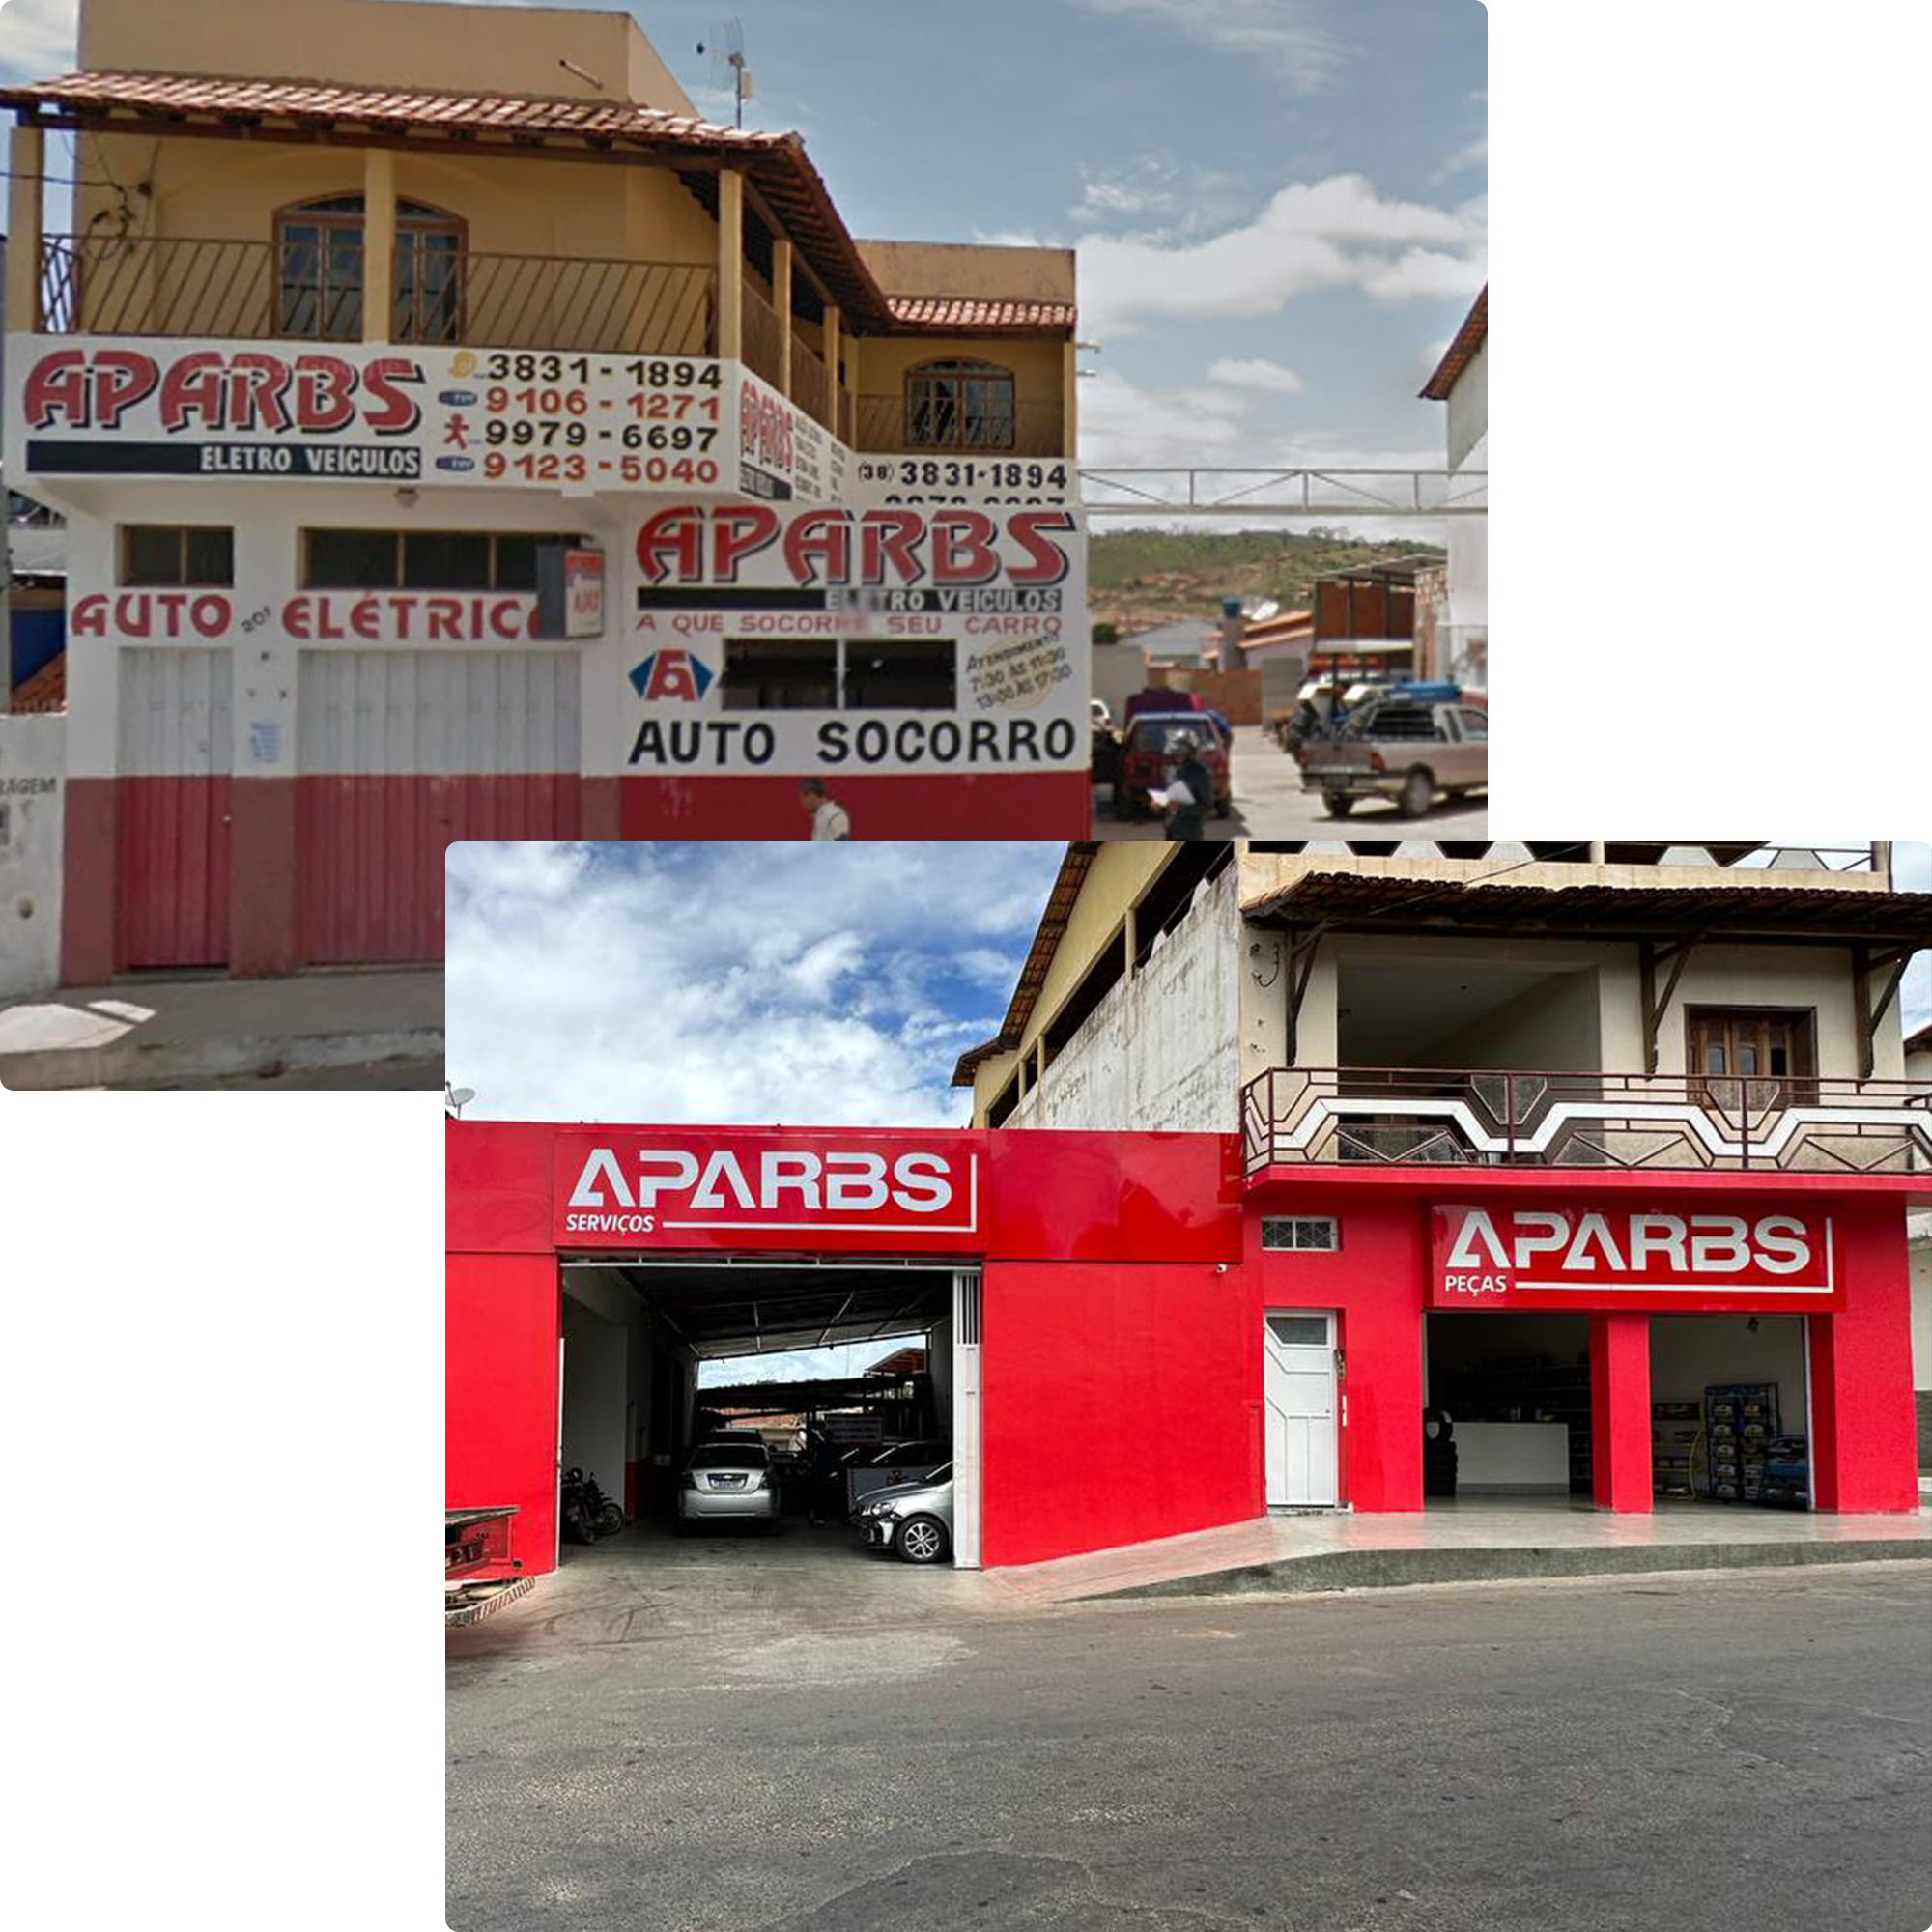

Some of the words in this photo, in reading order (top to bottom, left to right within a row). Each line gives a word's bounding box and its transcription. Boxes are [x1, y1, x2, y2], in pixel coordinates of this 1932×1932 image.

[24, 350, 426, 437] APARBS
[201, 445, 292, 471] ELETRO
[858, 462, 895, 482] (38)
[636, 505, 1076, 587] APARBS
[71, 593, 233, 638] AUTO
[635, 614, 657, 631] A
[672, 613, 724, 638] QUE
[888, 616, 943, 634] SEU
[965, 616, 1062, 635] CARRO
[628, 721, 775, 765] AUTO
[817, 718, 1075, 763] SOCORRO
[568, 1149, 952, 1212] APARBS
[566, 1214, 655, 1234] SERVIÇOS
[1446, 1211, 1811, 1274] APARBS
[1445, 1275, 1507, 1297] PEÇAS
